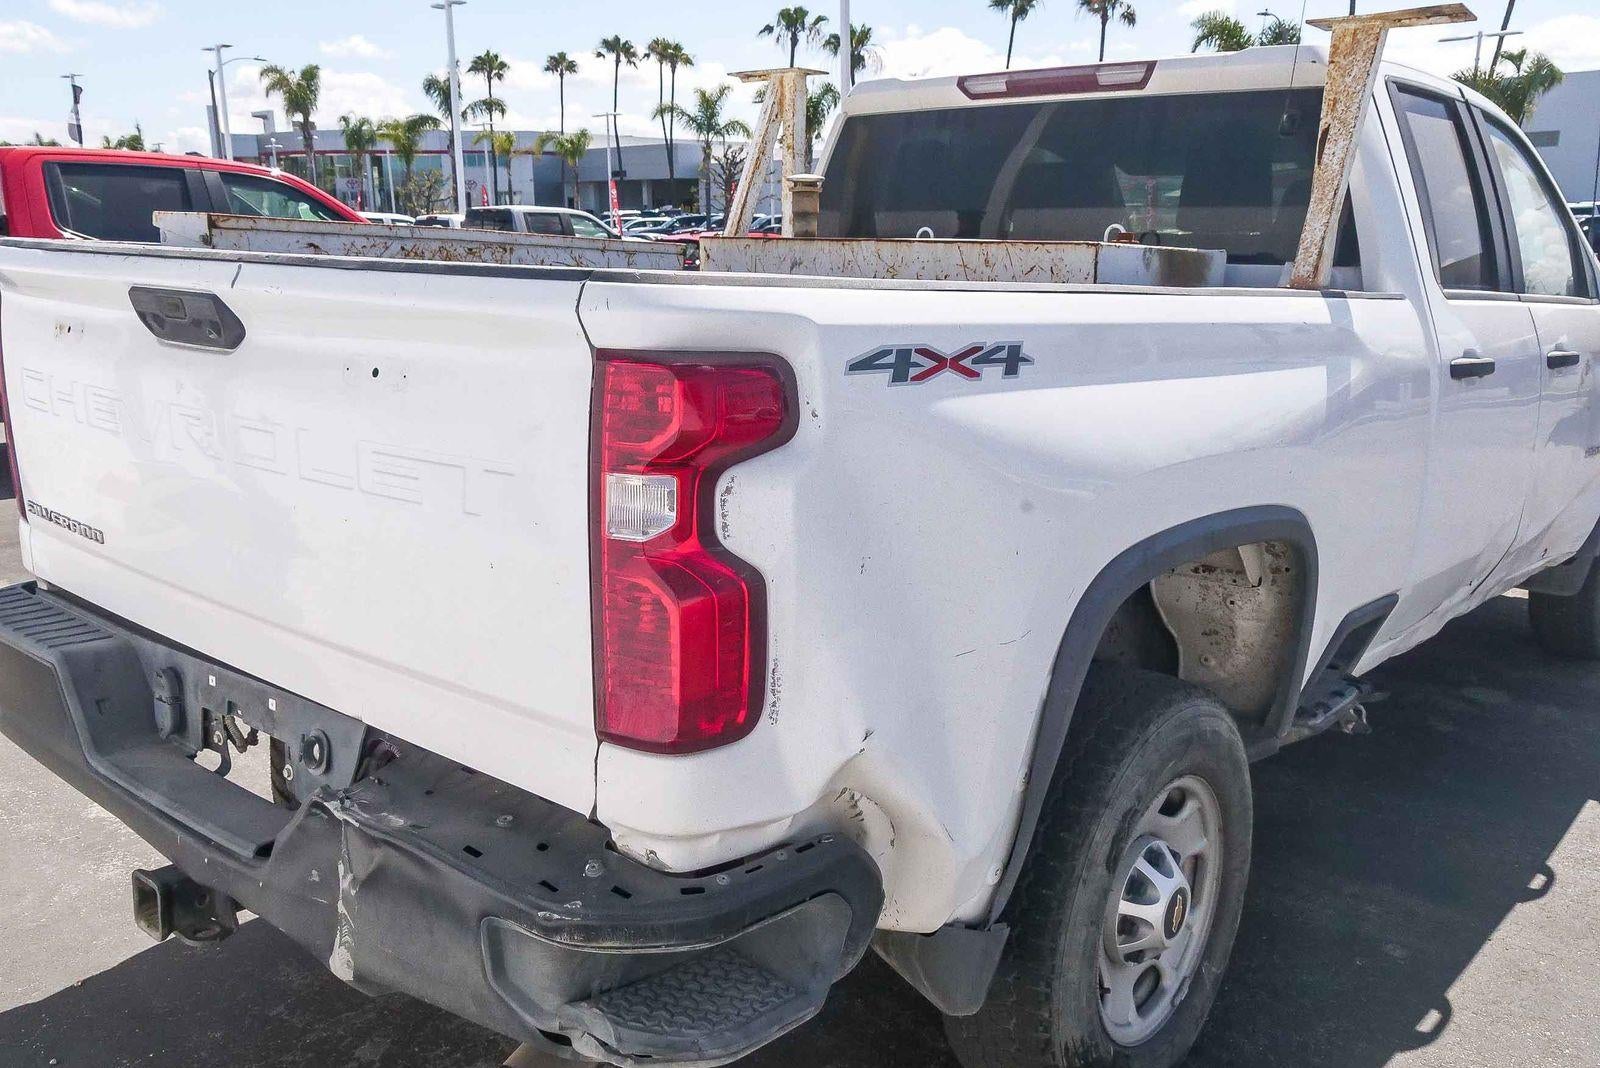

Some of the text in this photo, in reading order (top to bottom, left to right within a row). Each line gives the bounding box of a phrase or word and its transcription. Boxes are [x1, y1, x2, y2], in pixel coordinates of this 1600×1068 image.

[845, 341, 1035, 387] 4X4
[20, 366, 517, 518] CHEVROLET
[26, 499, 105, 545] SILVERADO
